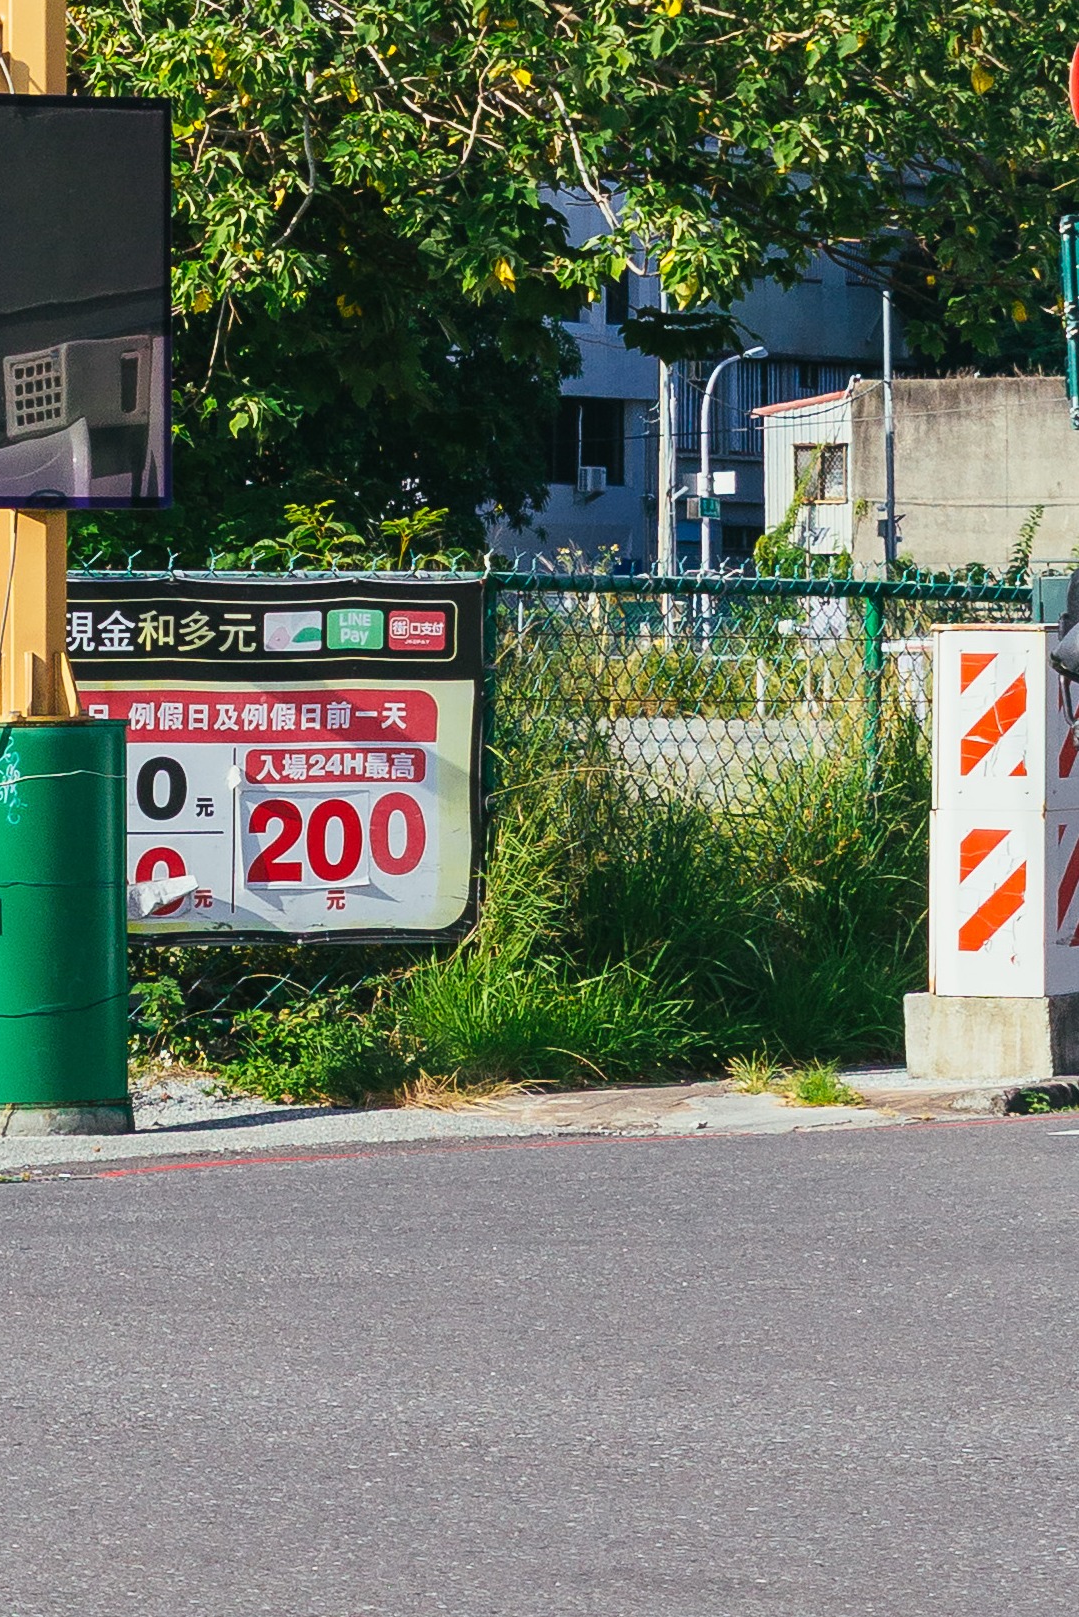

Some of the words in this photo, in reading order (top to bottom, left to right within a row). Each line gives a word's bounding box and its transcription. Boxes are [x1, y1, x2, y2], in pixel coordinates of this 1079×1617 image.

[339, 613, 371, 627] LINE
[340, 628, 369, 645] Pay
[128, 701, 407, 731] 例假日及例假日前一天
[255, 753, 415, 781] 入場24H最高
[196, 797, 215, 817] 元
[246, 791, 427, 882] 200
[194, 889, 214, 909] 元
[326, 890, 346, 911] 元
